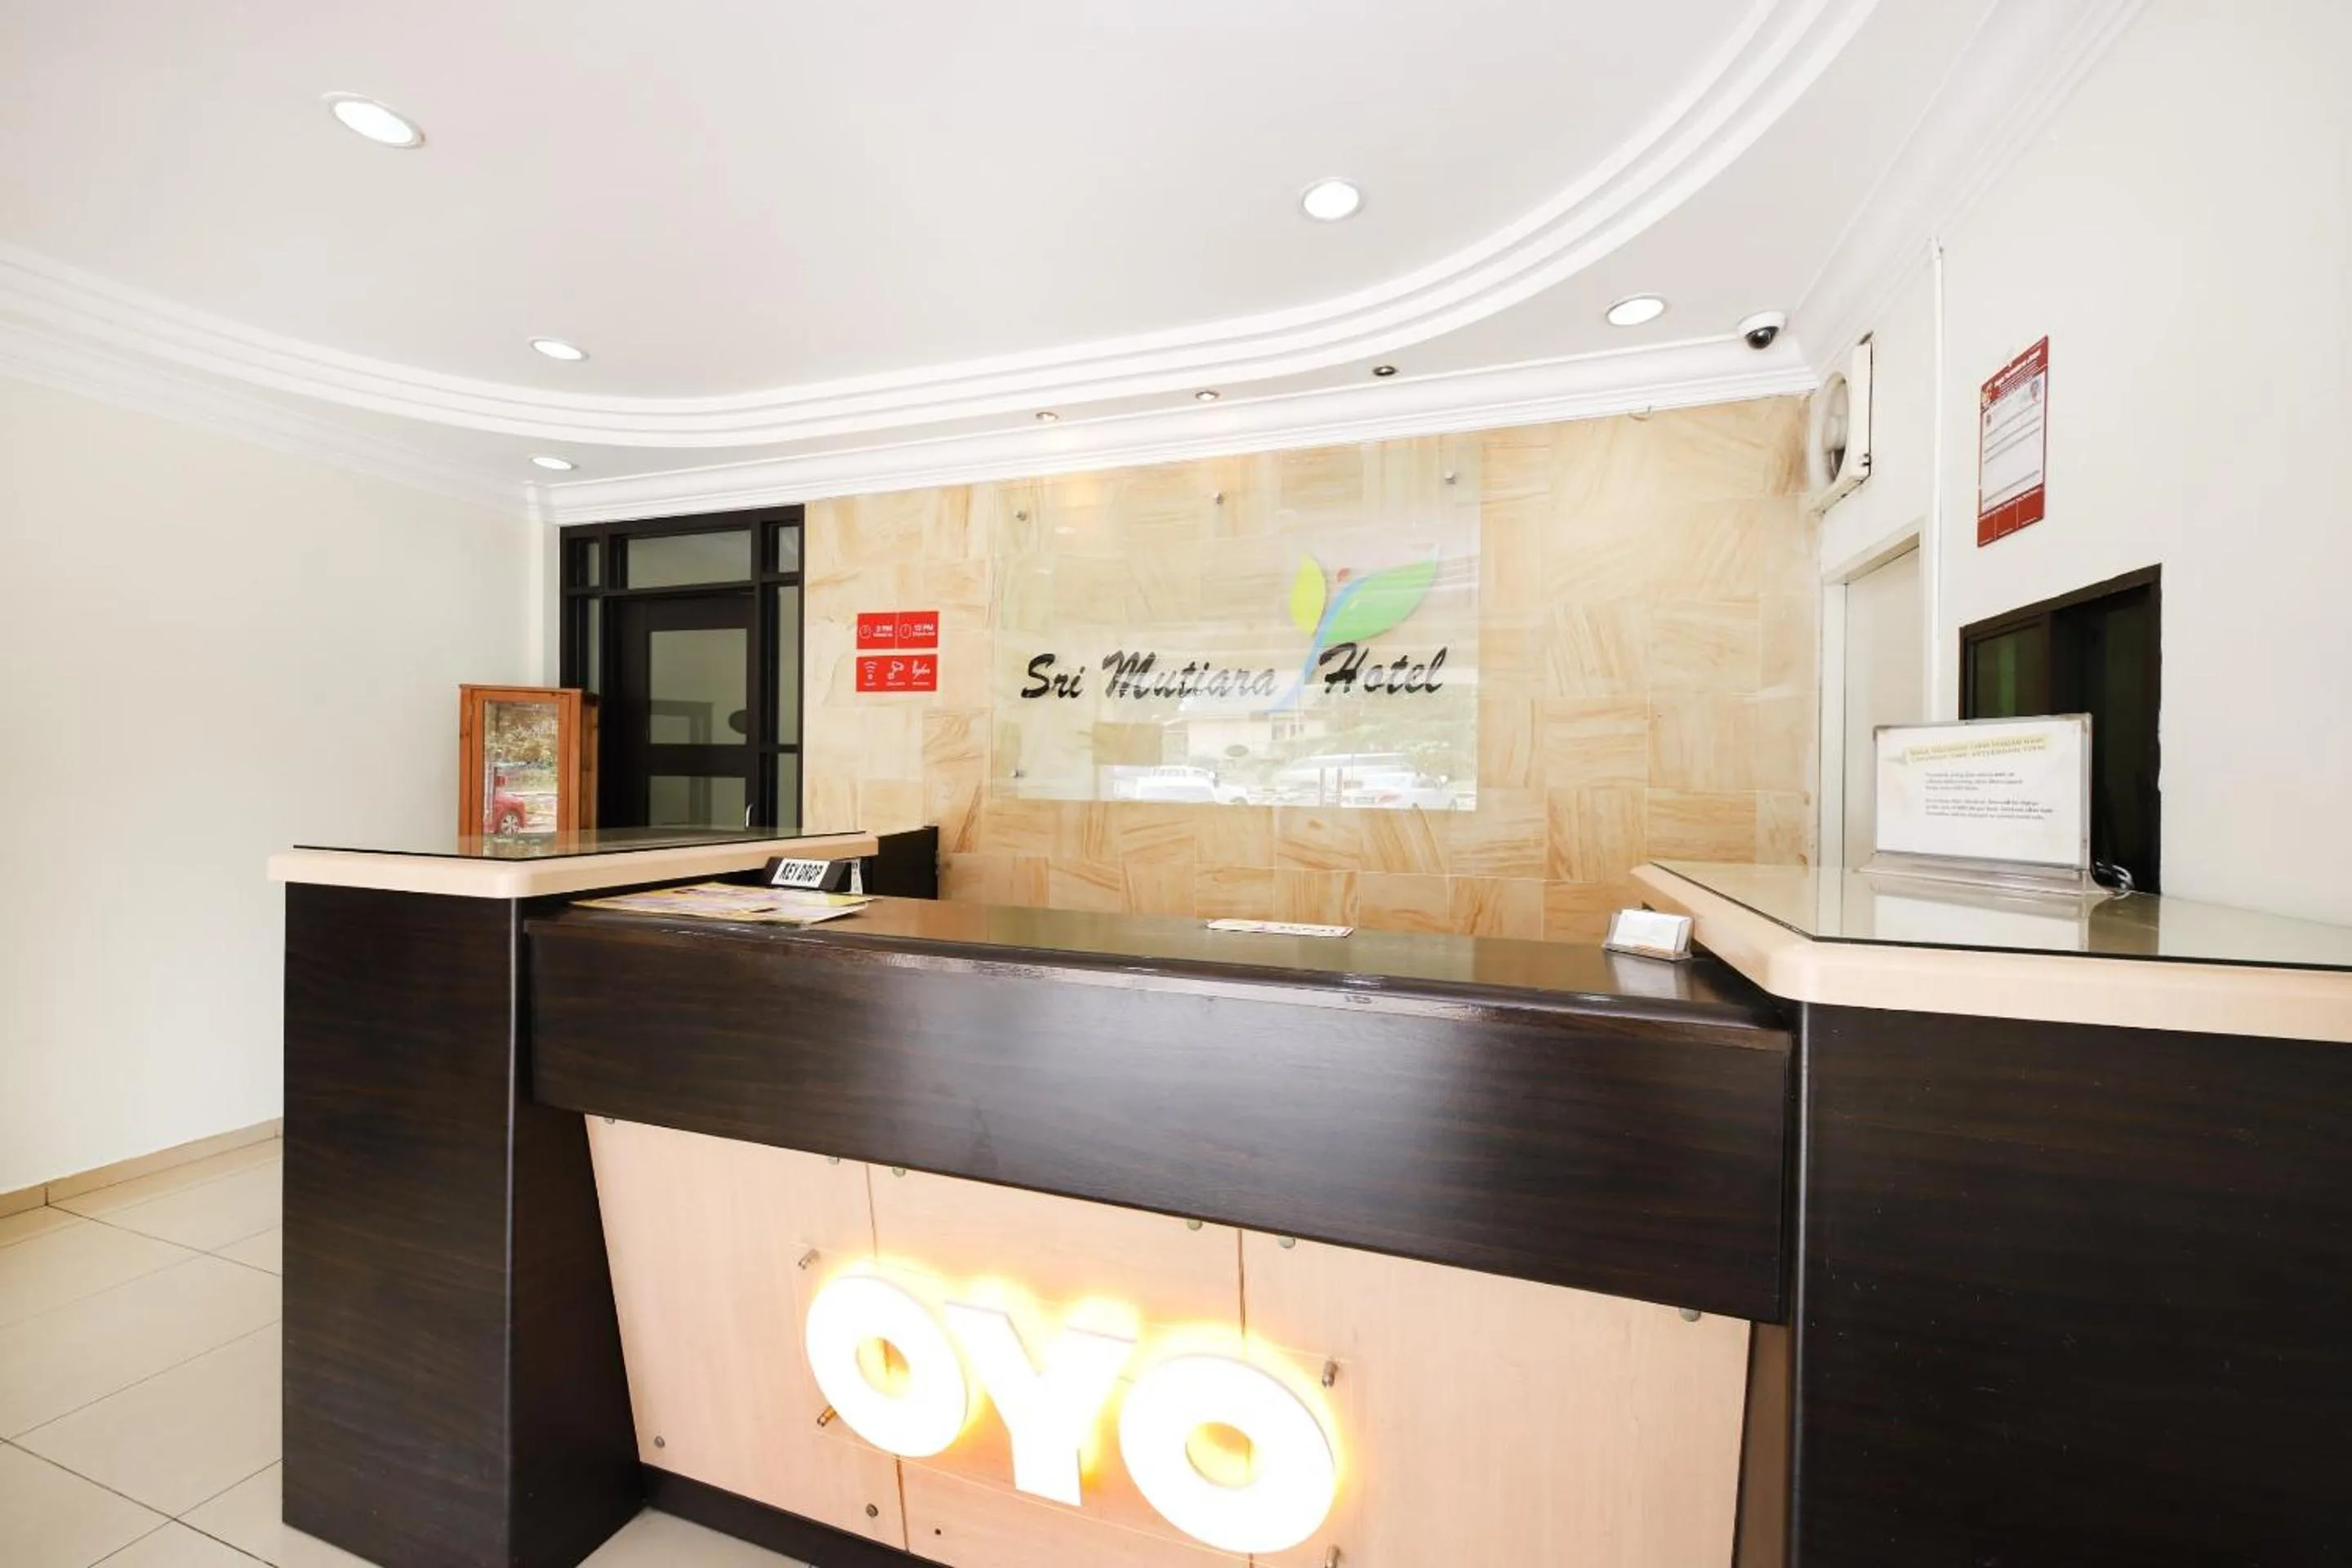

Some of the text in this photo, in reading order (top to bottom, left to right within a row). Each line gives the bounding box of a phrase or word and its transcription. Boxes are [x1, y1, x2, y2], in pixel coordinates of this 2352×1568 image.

[1020, 642, 1449, 699] Sri Mutiara Hotel
[779, 862, 823, 882] KEY DROP
[805, 1275, 1335, 1554] OYO
